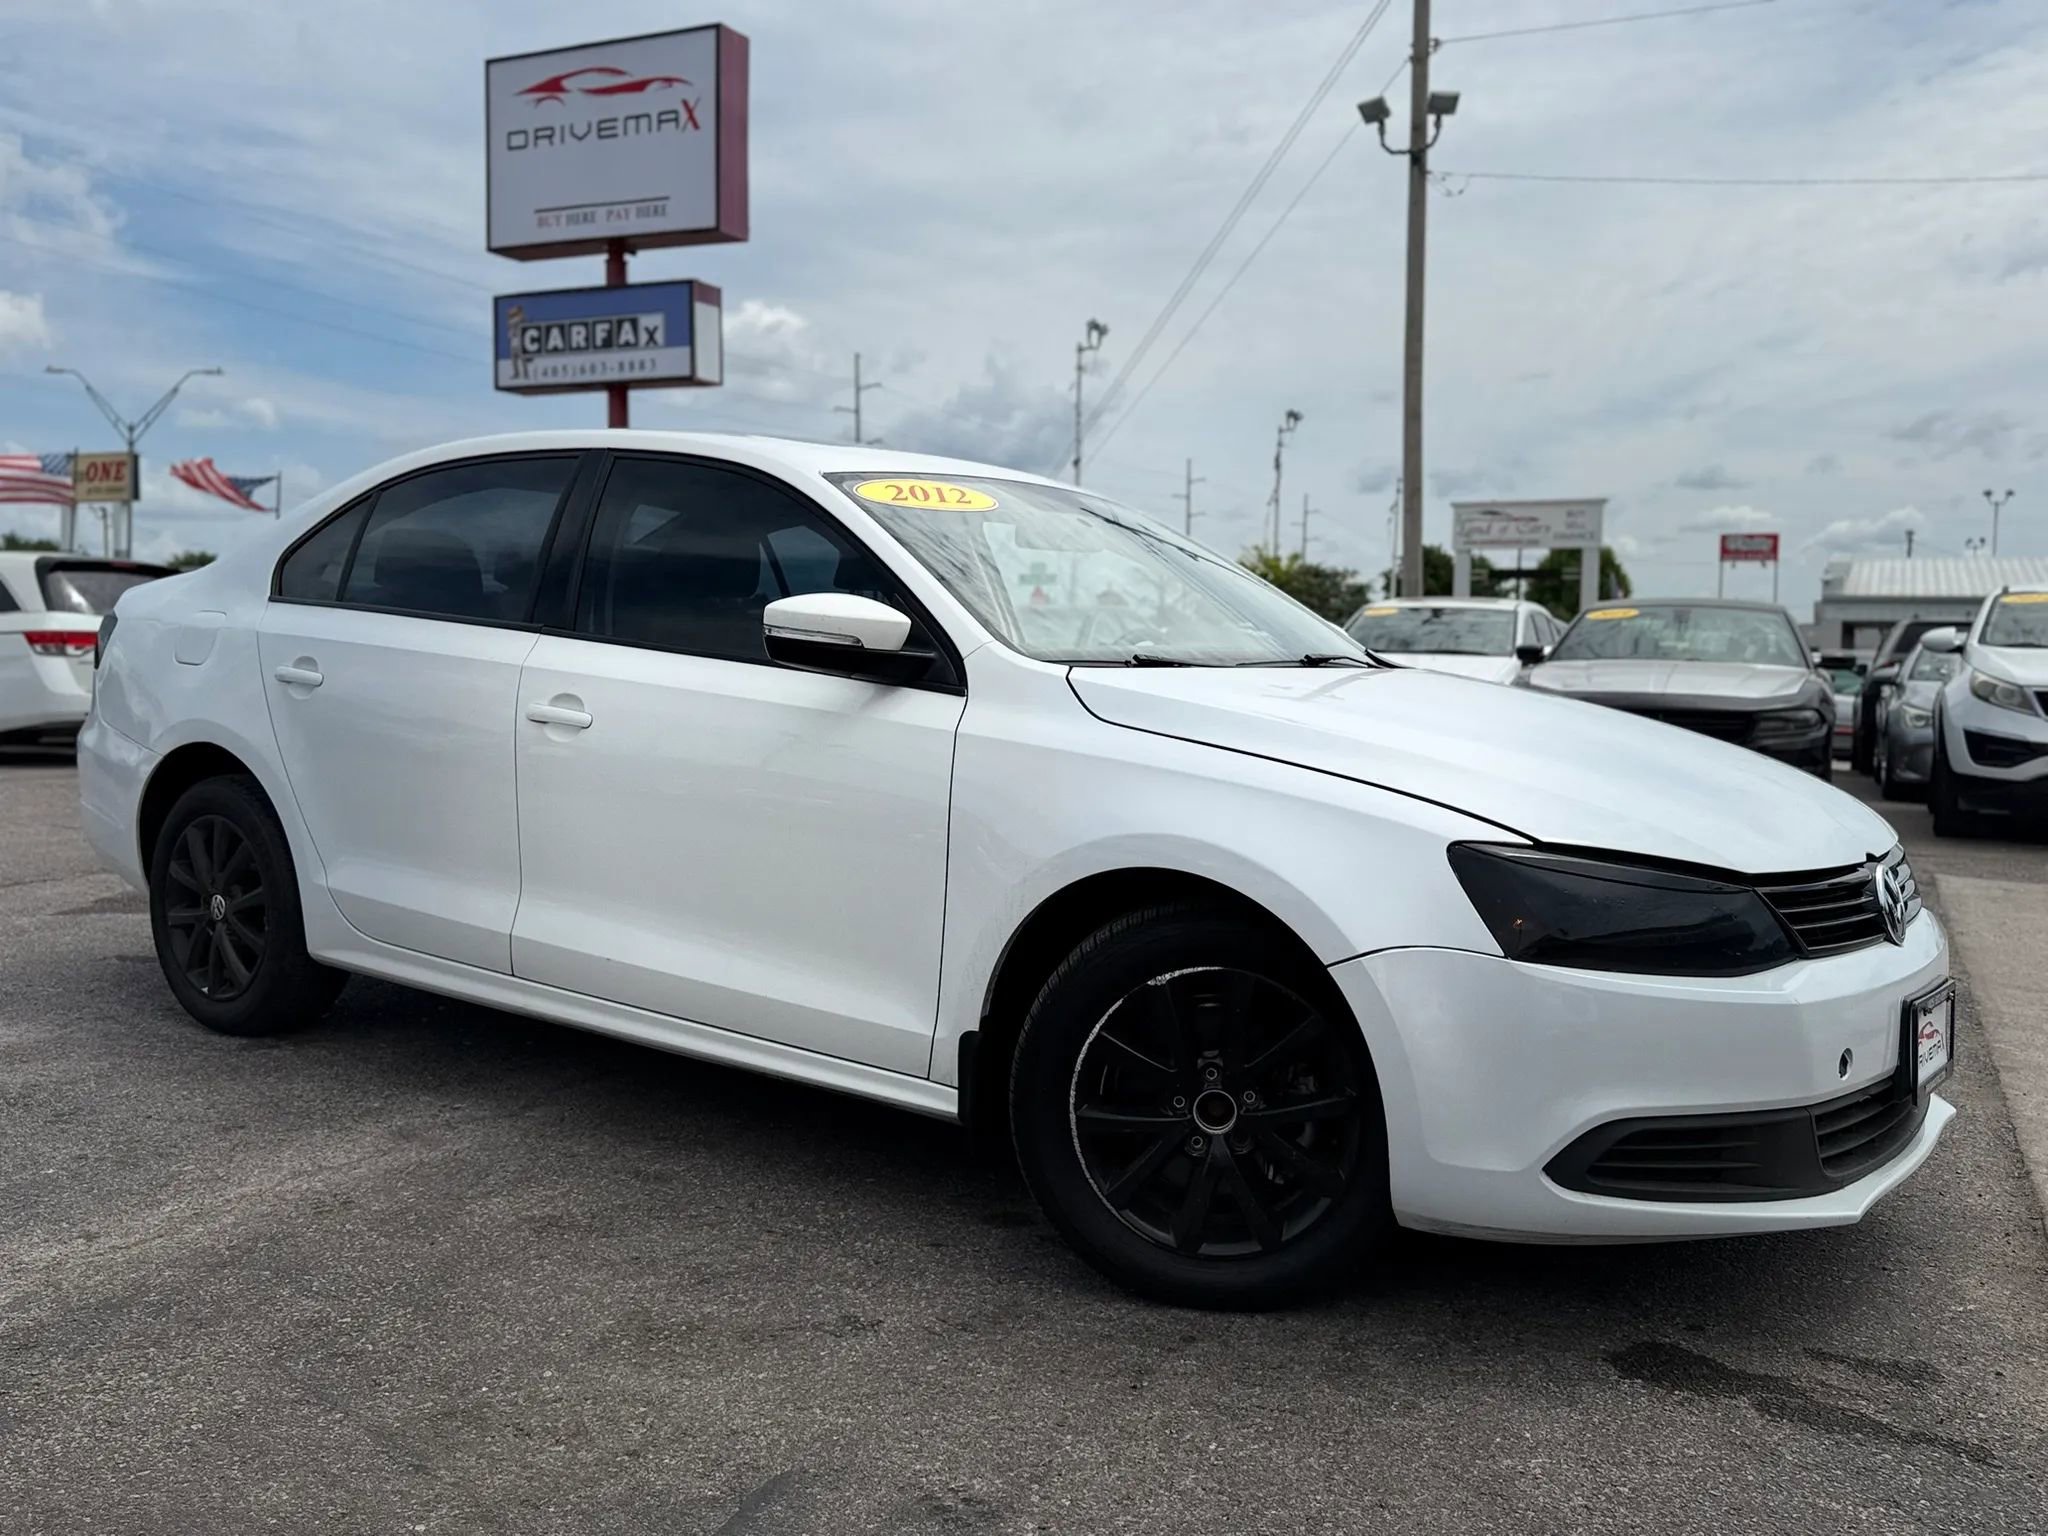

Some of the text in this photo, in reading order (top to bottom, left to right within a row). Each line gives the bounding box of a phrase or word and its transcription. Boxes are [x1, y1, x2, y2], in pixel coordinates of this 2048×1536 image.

[507, 97, 700, 152] DRIVEMAX
[523, 319, 662, 353] CARFAX
[86, 460, 127, 483] ONE
[885, 485, 972, 504] 2012
